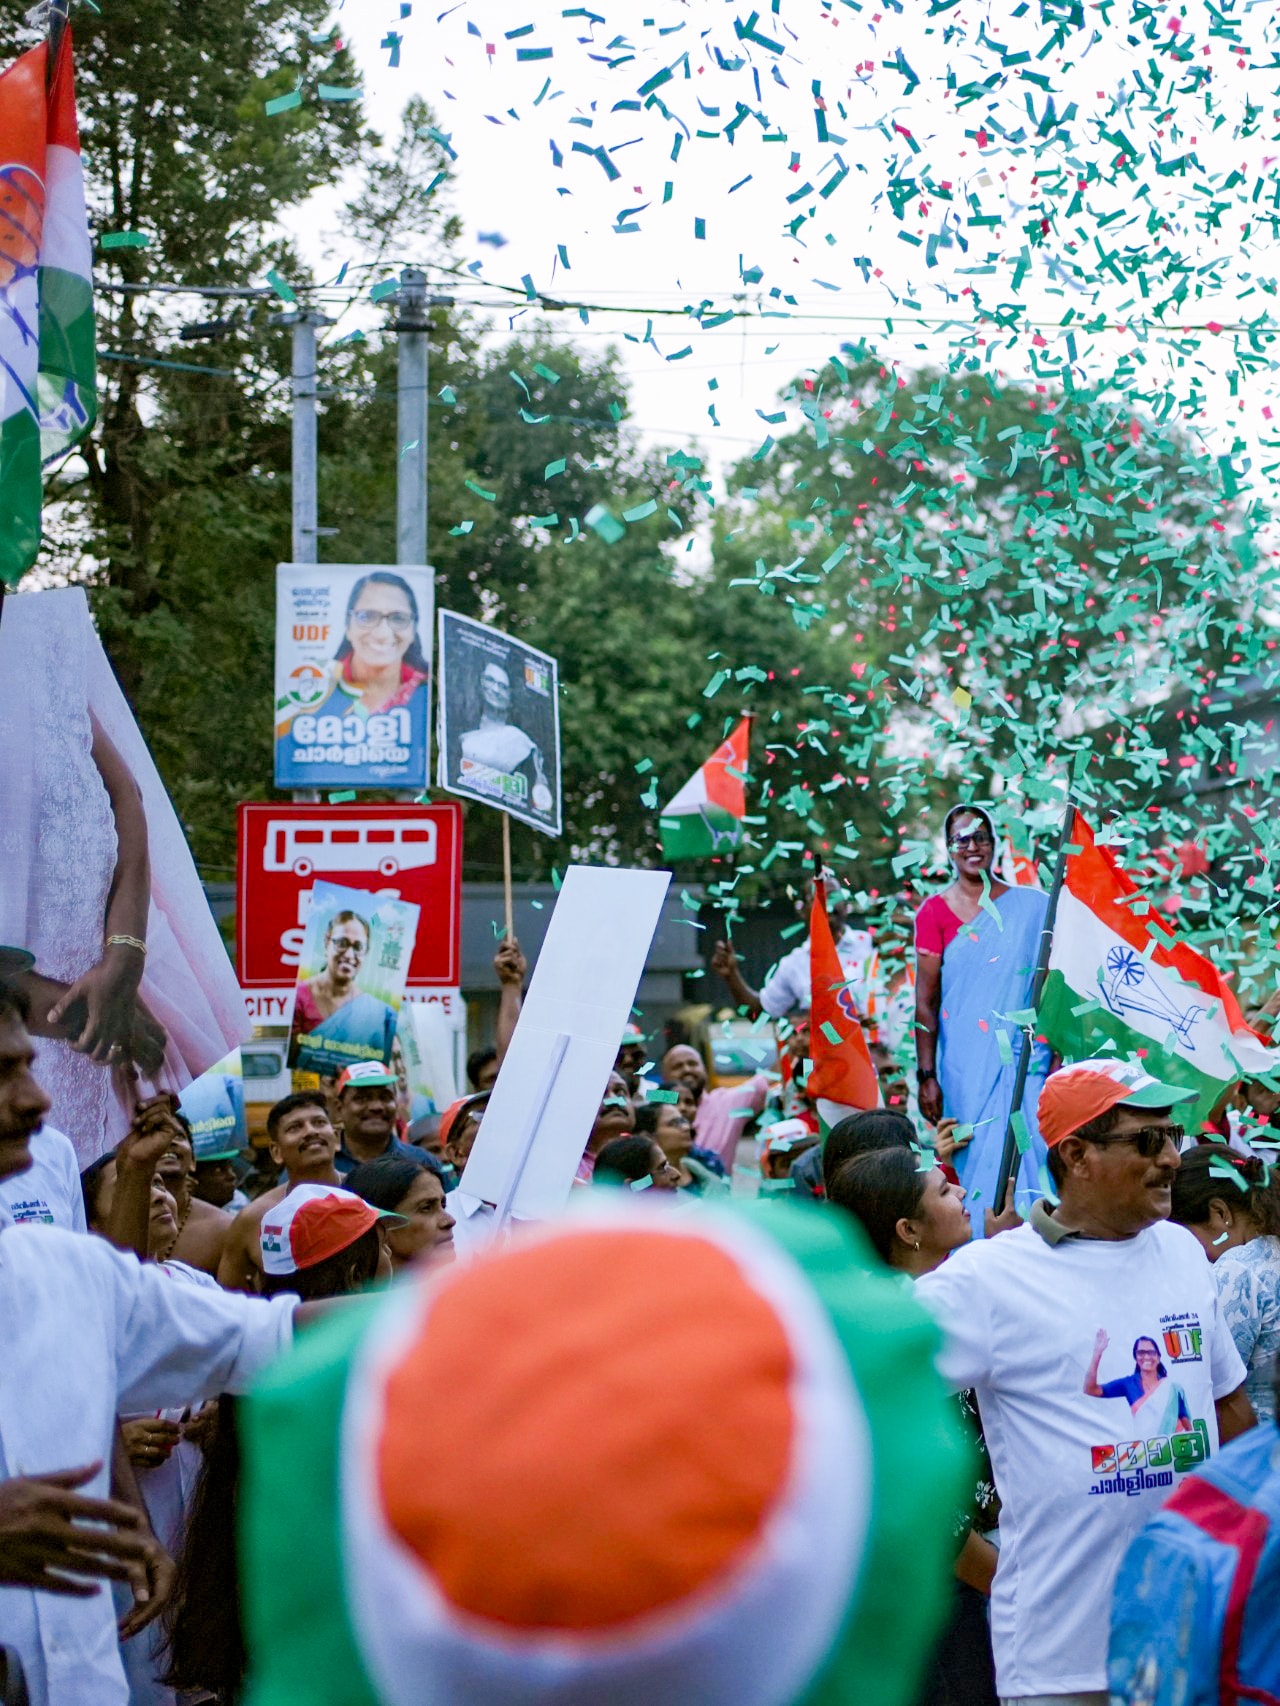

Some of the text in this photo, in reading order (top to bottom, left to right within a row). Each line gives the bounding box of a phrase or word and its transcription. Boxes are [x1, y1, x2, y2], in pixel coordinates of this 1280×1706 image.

[293, 624, 331, 641] UDF
[292, 707, 411, 747] മോളി
[245, 997, 288, 1016] CITY
[1163, 1329, 1202, 1359] UDF
[1091, 1419, 1210, 1474] മോളി
[1088, 1468, 1173, 1496] ചാർളിയെ
